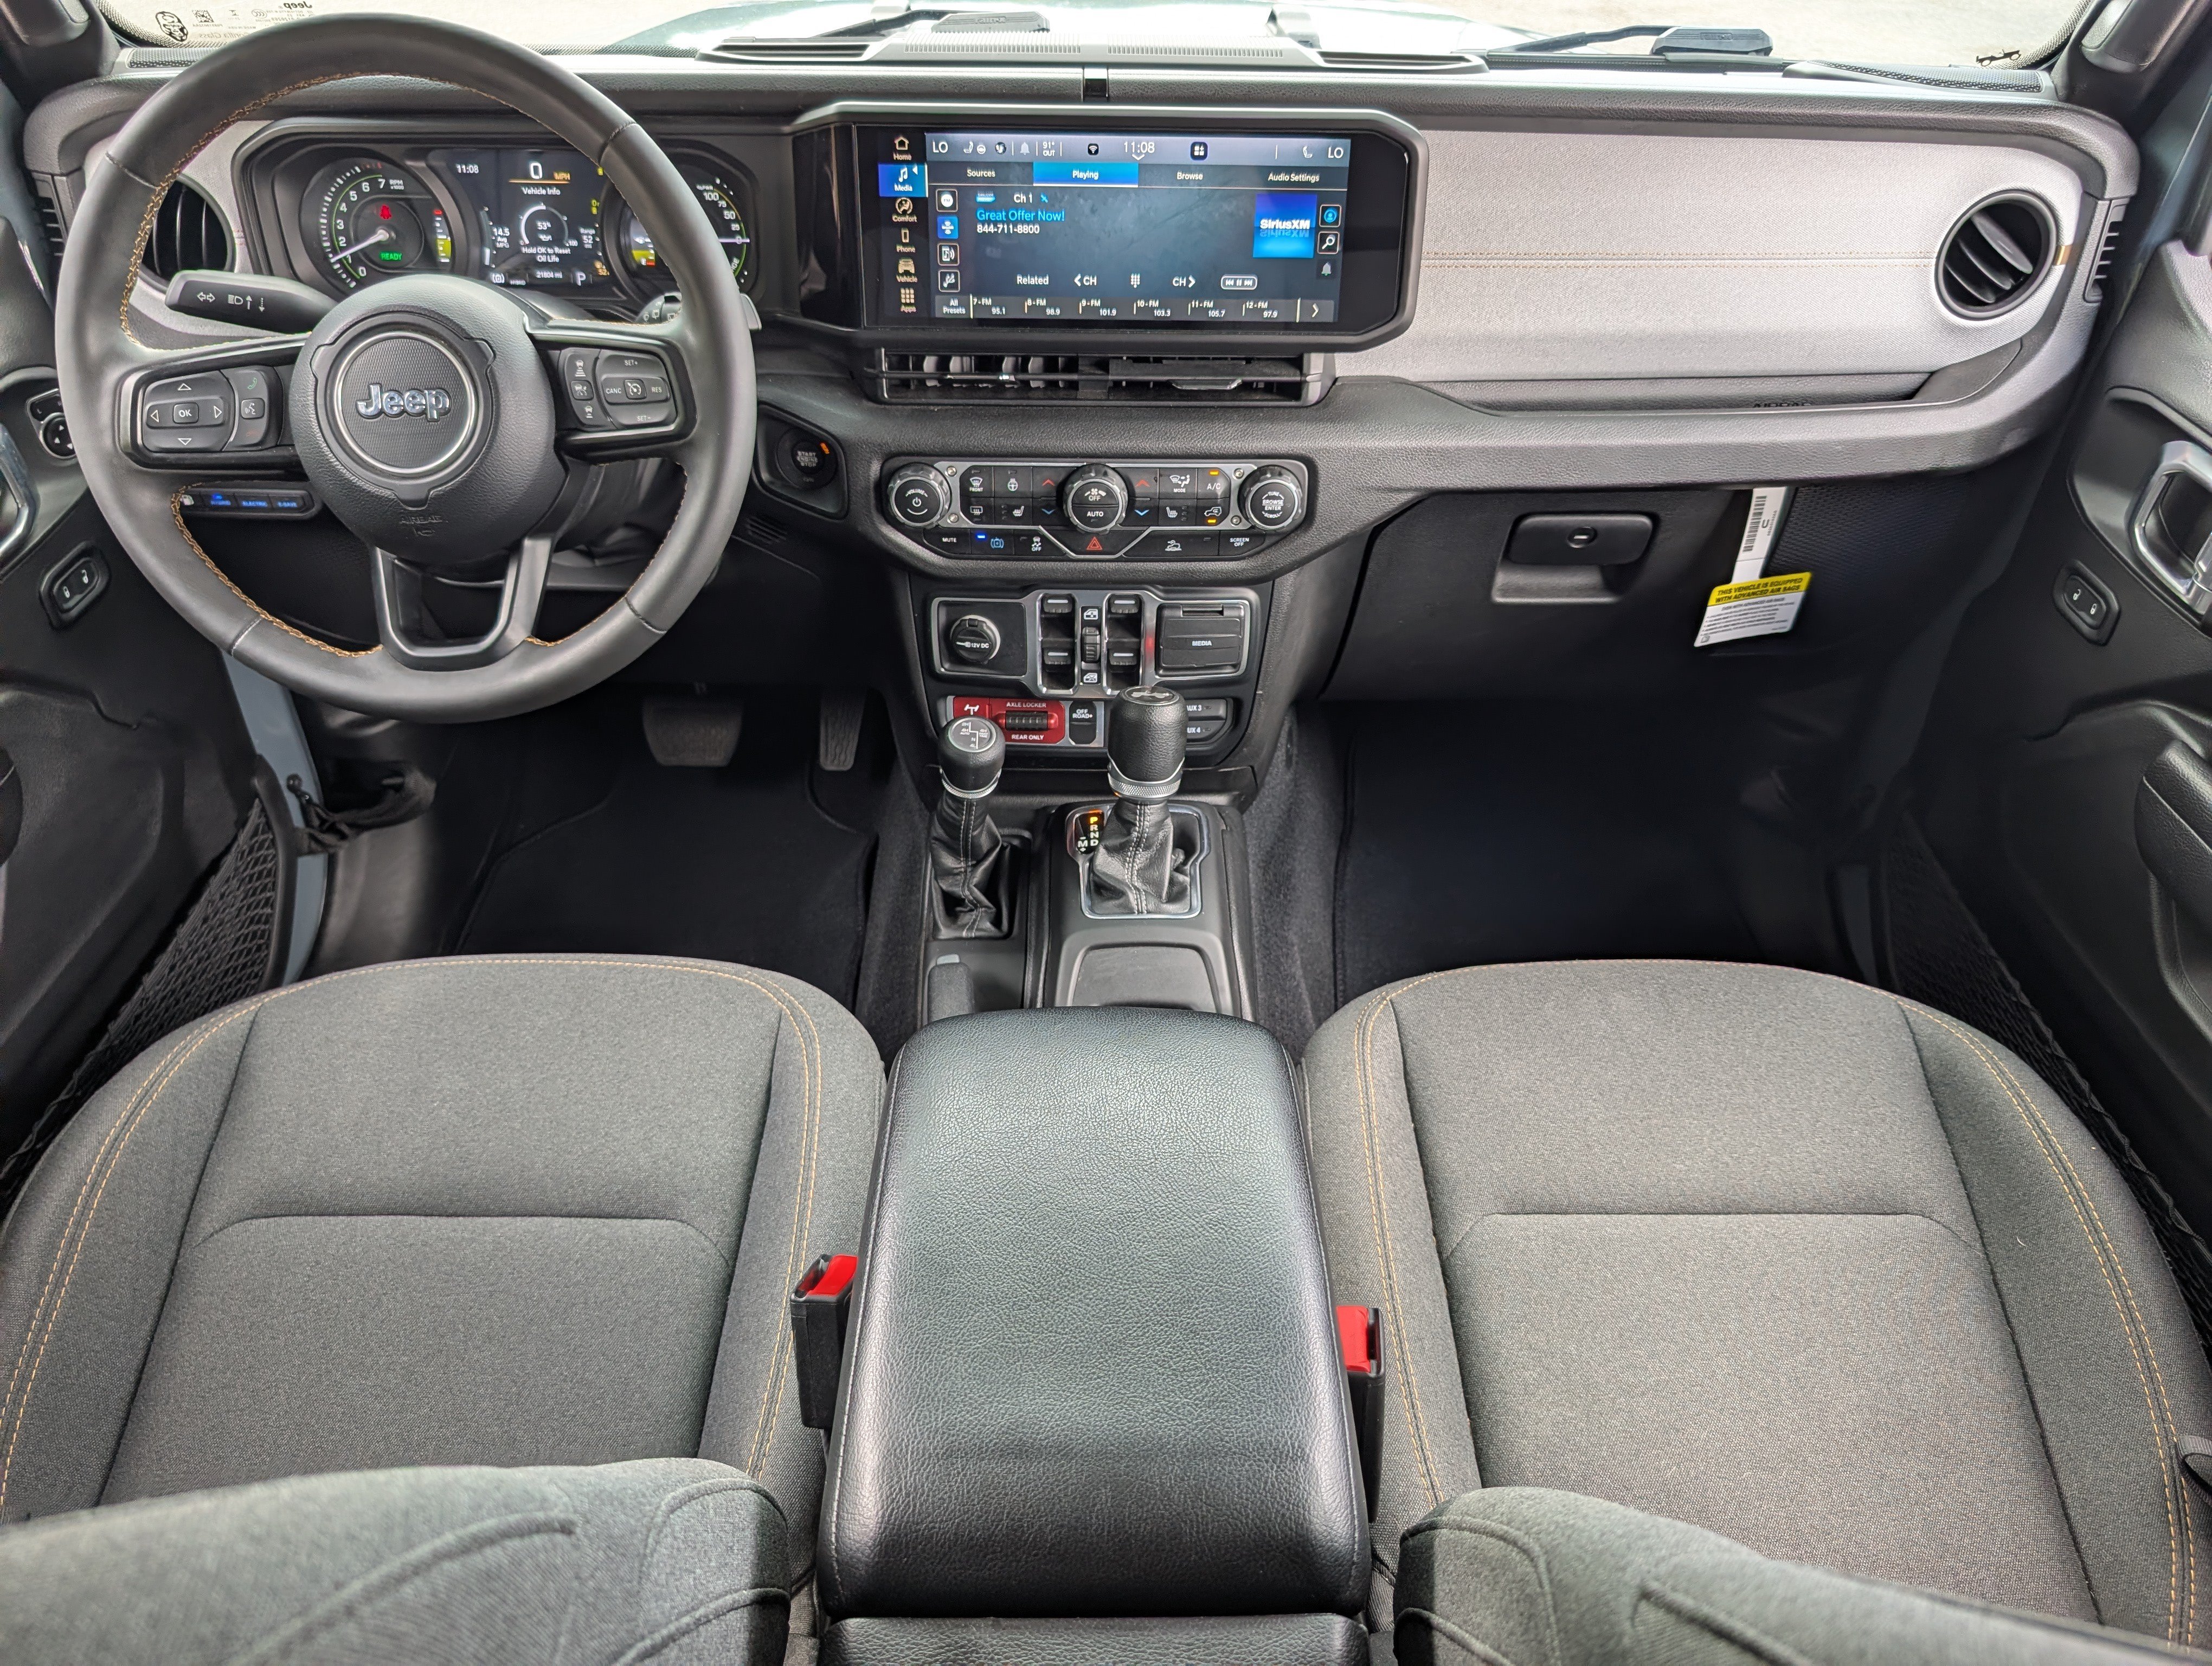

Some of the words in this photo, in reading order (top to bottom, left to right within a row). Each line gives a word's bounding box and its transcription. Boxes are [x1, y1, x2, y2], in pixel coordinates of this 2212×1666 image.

[933, 142, 948, 153] LO
[1124, 142, 1155, 153] 11:08
[1328, 148, 1344, 158] LO
[456, 164, 479, 174] 11:08
[529, 162, 542, 179] 0
[967, 169, 995, 177] Sources
[554, 172, 570, 180] MPH
[1072, 170, 1098, 181] Playing
[1177, 172, 1203, 180] Browse
[1268, 173, 1289, 182] Audio
[1290, 174, 1320, 183] Settings
[362, 182, 370, 192] 6
[378, 178, 385, 189] 7
[349, 191, 357, 201] 5
[522, 187, 546, 195] Vehicle
[703, 192, 719, 201] 100
[1014, 194, 1026, 203] Ch
[1029, 194, 1033, 203] 1
[340, 202, 347, 212] 4
[723, 210, 736, 220] 50
[977, 209, 1006, 221] Great
[1008, 210, 1037, 222] Offer
[1038, 210, 1065, 222] Now!
[337, 219, 344, 229] 3
[977, 223, 1040, 234] 844-711-8800
[1259, 219, 1310, 230] SiriusXM
[896, 245, 915, 253] Phone
[381, 252, 402, 260] READY
[548, 254, 560, 262] Life
[575, 271, 586, 286] P
[1017, 275, 1049, 285] Related
[1083, 277, 1097, 286] CH
[1173, 277, 1186, 286] CH
[950, 298, 958, 306] All
[901, 305, 916, 313] Apps
[943, 306, 966, 314] Presets
[991, 306, 1006, 315] 95.1
[356, 383, 452, 423] Jeep
[179, 409, 191, 418] OK
